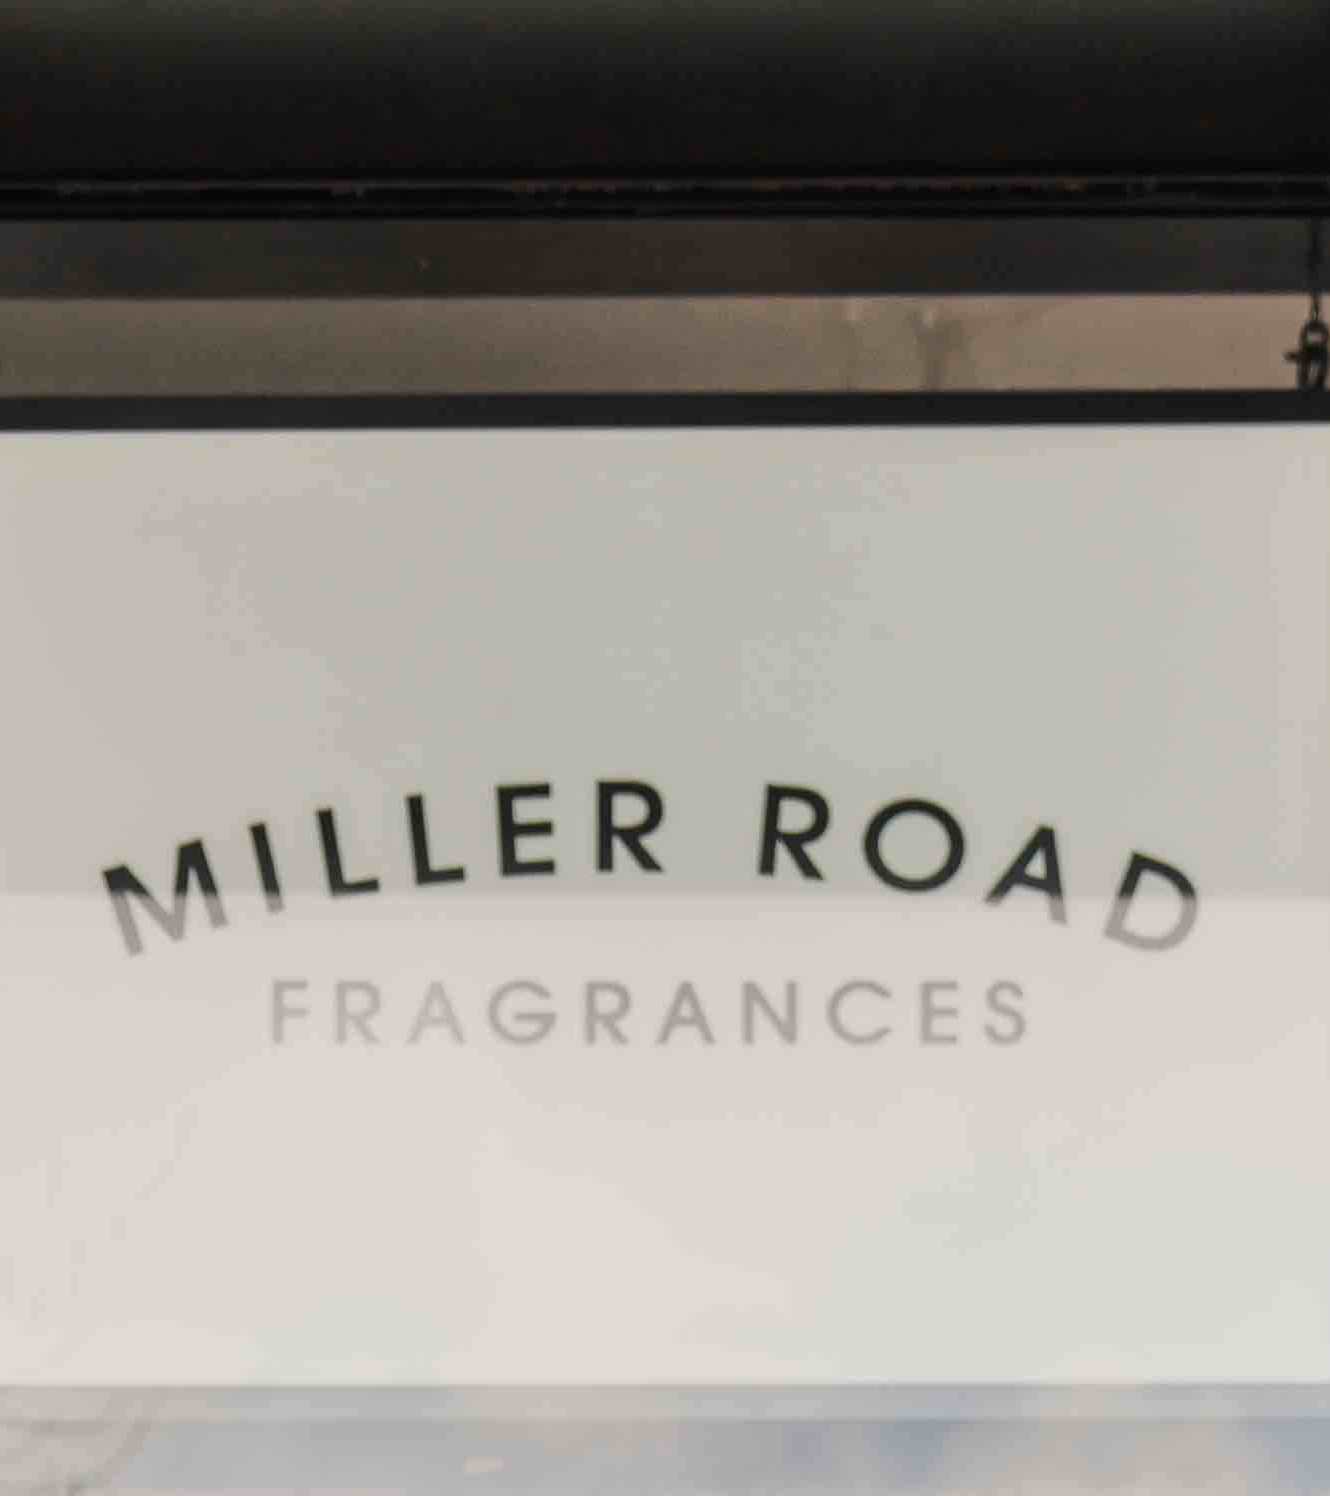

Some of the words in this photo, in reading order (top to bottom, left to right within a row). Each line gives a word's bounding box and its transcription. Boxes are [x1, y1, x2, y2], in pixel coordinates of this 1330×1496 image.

[101, 779, 665, 957] MILLER
[756, 784, 1199, 952] ROAD
[271, 979, 1028, 1047] FRAGRANCES
